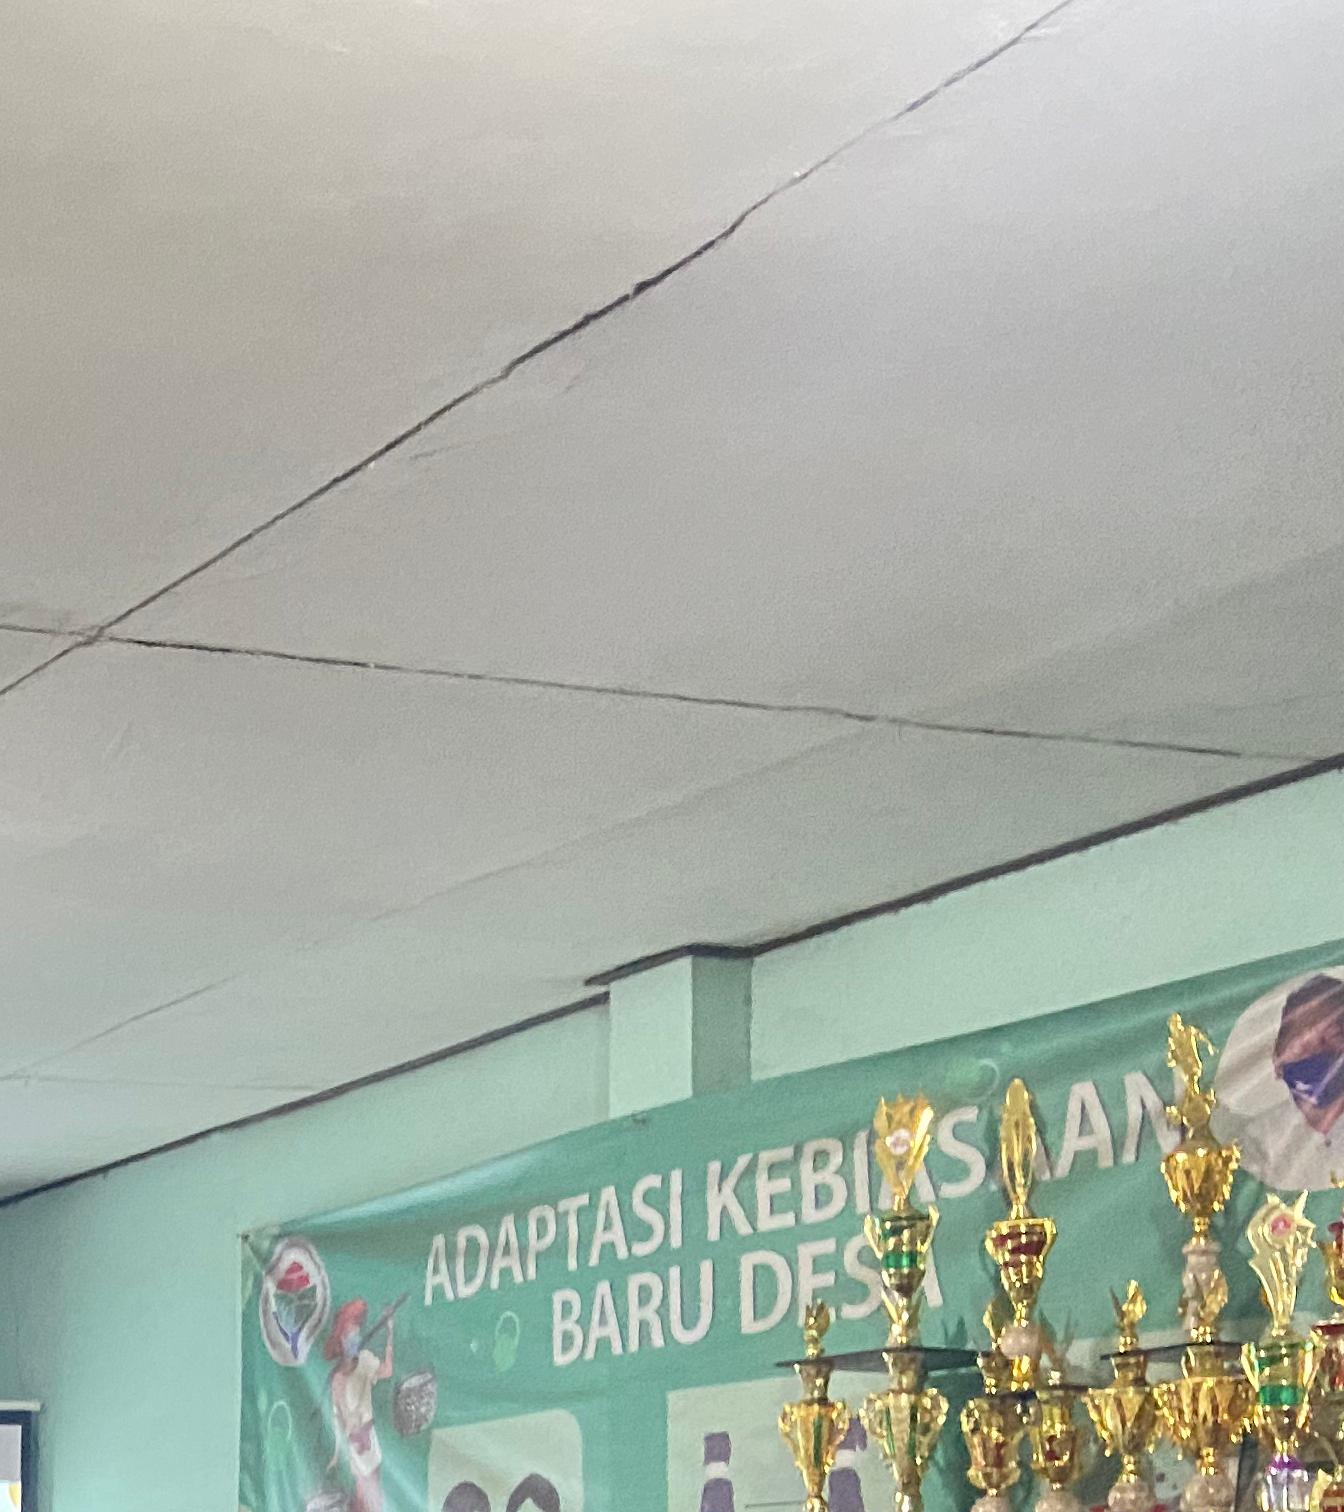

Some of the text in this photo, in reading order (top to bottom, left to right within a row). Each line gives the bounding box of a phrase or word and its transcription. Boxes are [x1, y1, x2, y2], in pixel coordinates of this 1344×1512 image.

[424, 1066, 1187, 1306] ADAPTASI KEBISAN
[552, 1259, 714, 1367] BARU
